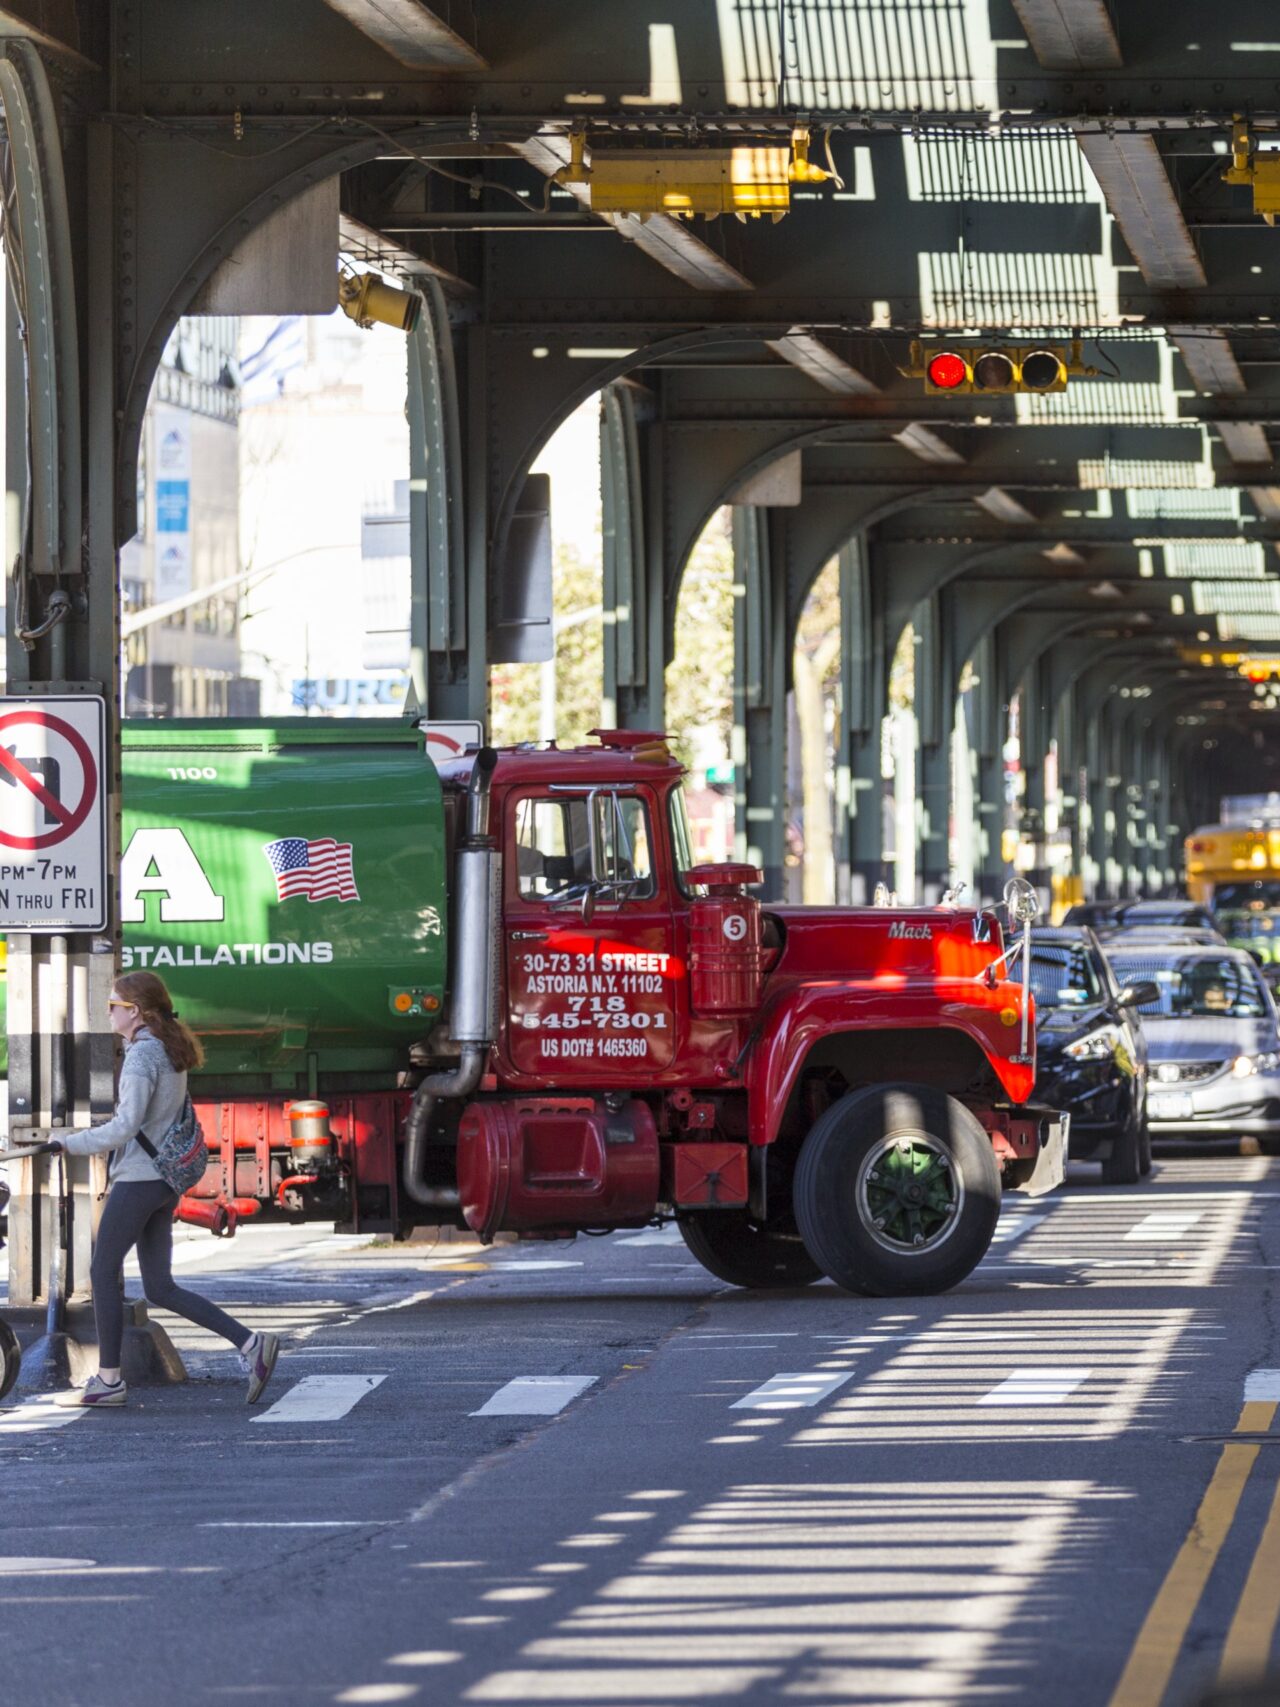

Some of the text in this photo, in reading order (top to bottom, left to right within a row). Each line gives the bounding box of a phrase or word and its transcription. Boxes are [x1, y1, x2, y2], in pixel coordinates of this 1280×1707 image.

[167, 766, 218, 781] 1100
[121, 827, 225, 923] A
[16, 895, 53, 909] THRU
[61, 888, 94, 909] FRI
[729, 918, 741, 936] 5
[888, 921, 933, 940] Mack
[121, 942, 334, 968] STALLATIONS
[523, 953, 670, 972] 30-73 31 STREET
[527, 975, 663, 993] ASTORIA N.Y. 11102
[568, 996, 626, 1012] 718
[522, 1013, 667, 1029] 545-7301
[541, 1038, 647, 1057] US DOT# 1465360
